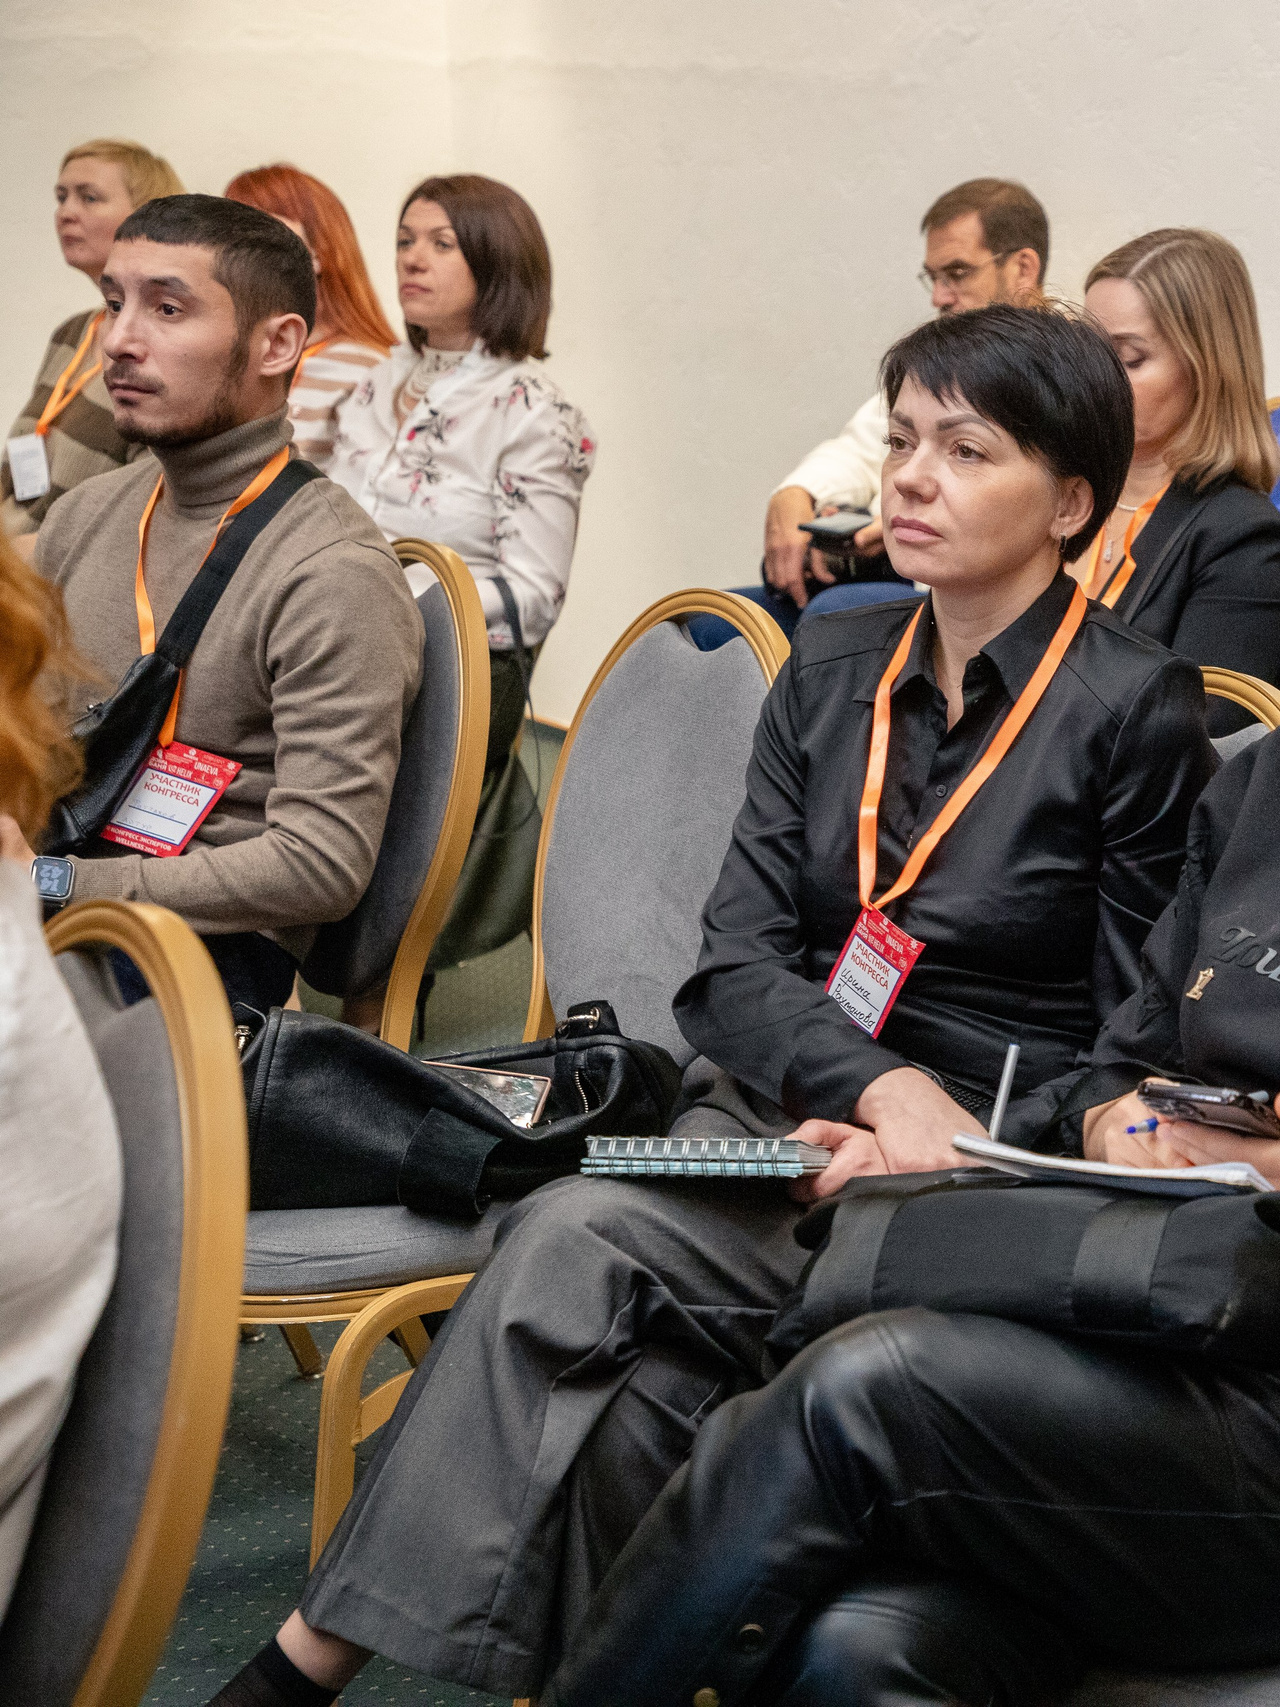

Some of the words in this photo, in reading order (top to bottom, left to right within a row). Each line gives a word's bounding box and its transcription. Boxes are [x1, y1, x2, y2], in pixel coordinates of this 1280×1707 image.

[144, 782, 199, 807] КОНГРЕССА
[150, 772, 202, 796] УЧАСТНИК
[115, 836, 144, 852] WELLNESS
[850, 951, 889, 990] КОНГРЕССА
[855, 941, 890, 977] УЧАСТНИК
